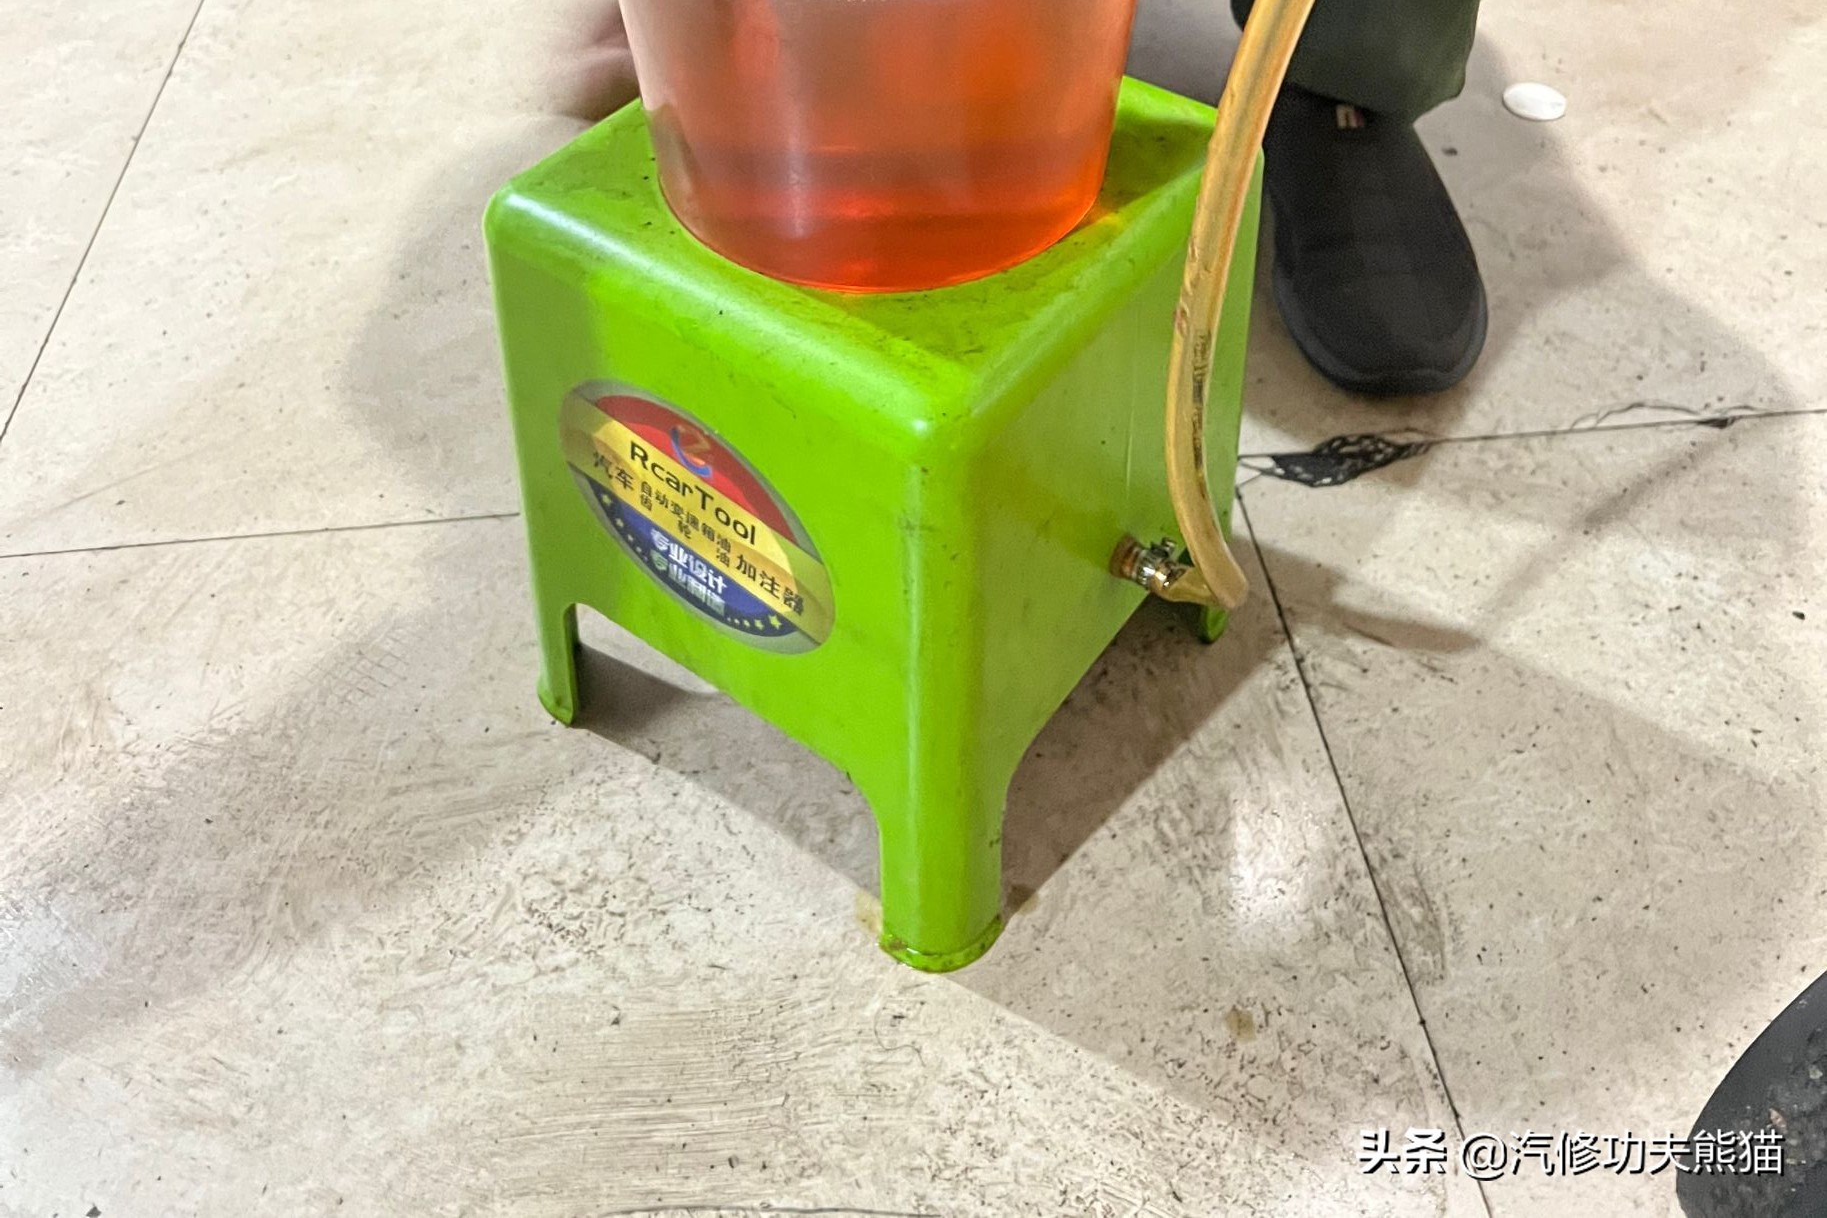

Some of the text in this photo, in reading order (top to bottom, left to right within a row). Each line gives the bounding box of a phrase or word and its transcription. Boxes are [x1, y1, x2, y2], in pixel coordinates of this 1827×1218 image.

[592, 450, 635, 492] 汽车
[736, 554, 804, 616] 加注器
[630, 441, 755, 546] RcarTool
[650, 528, 727, 594] 专业设计
